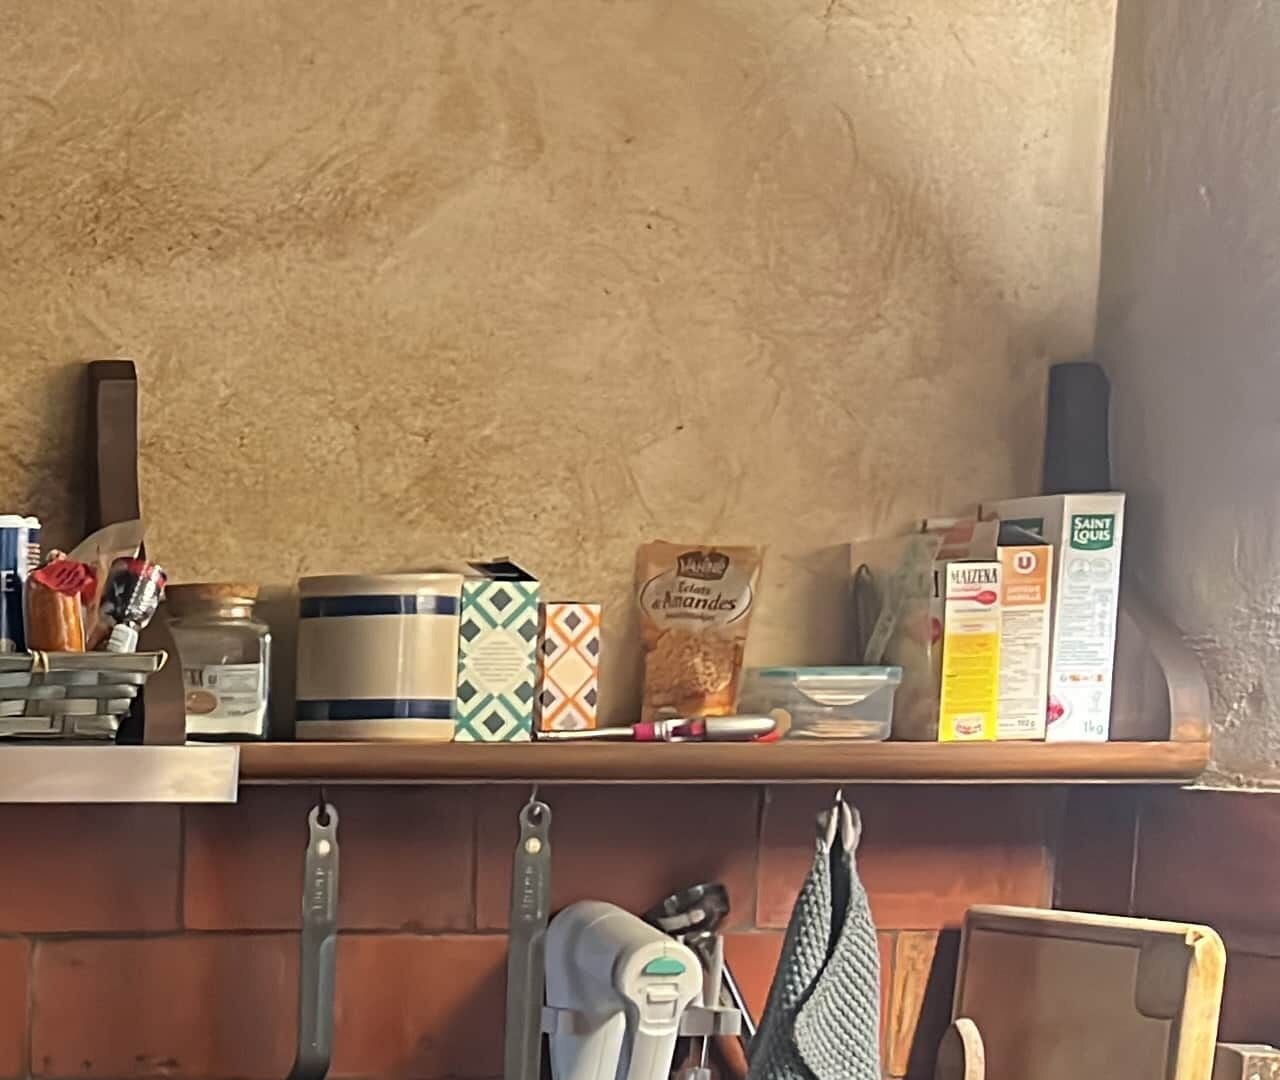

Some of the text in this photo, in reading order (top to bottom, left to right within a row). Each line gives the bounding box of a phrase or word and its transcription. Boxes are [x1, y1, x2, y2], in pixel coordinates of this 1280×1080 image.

[1074, 516, 1113, 529] SAINT
[1073, 529, 1111, 544] LOUIS
[1018, 556, 1032, 570] U
[951, 568, 998, 584] MAIZENA
